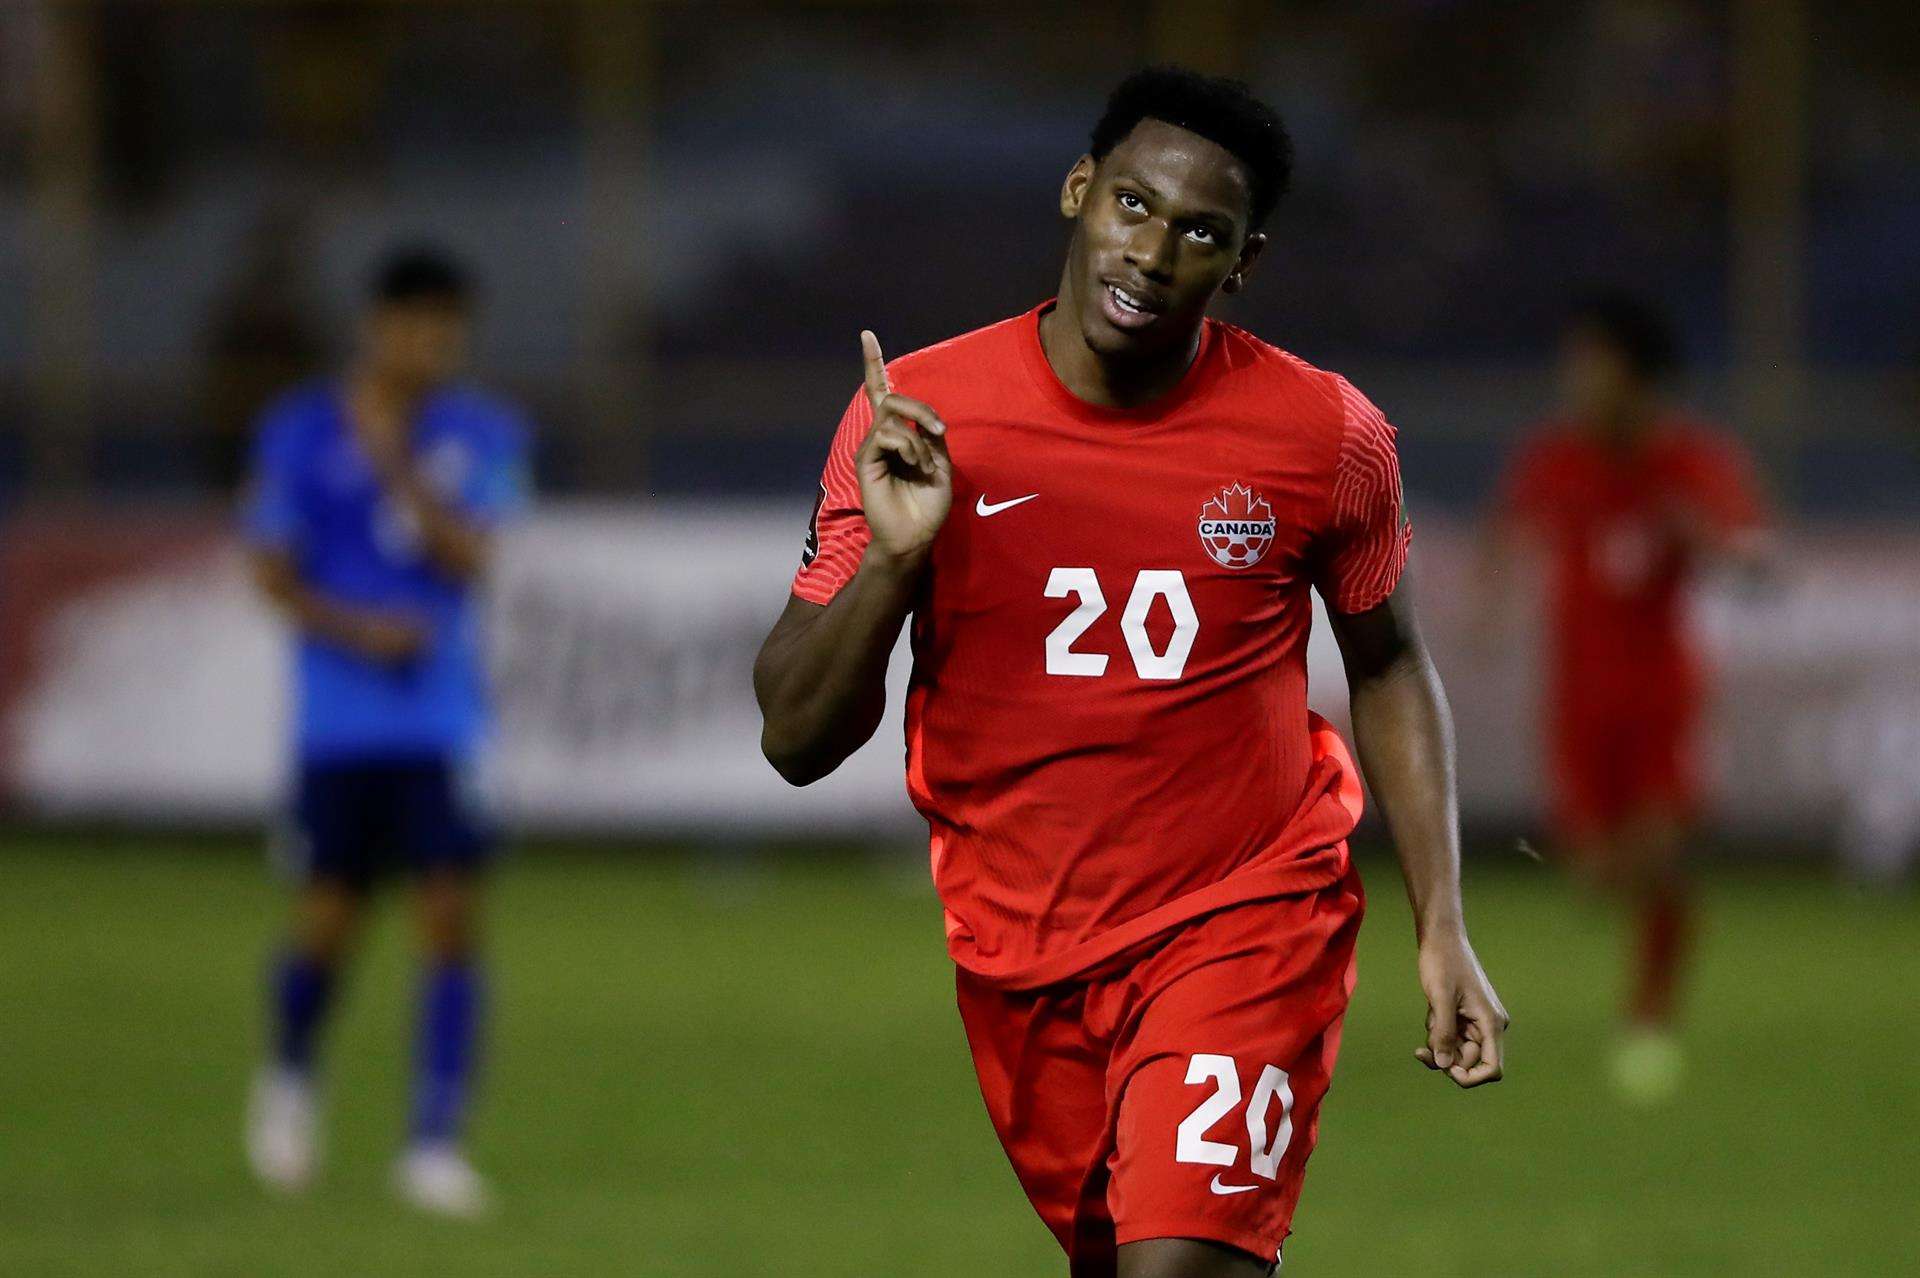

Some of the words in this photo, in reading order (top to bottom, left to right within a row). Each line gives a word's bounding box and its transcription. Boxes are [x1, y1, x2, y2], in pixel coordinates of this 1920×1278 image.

[1200, 523, 1272, 536] CANADA
[1043, 567, 1200, 680] 20
[1175, 1053, 1294, 1181] 20
